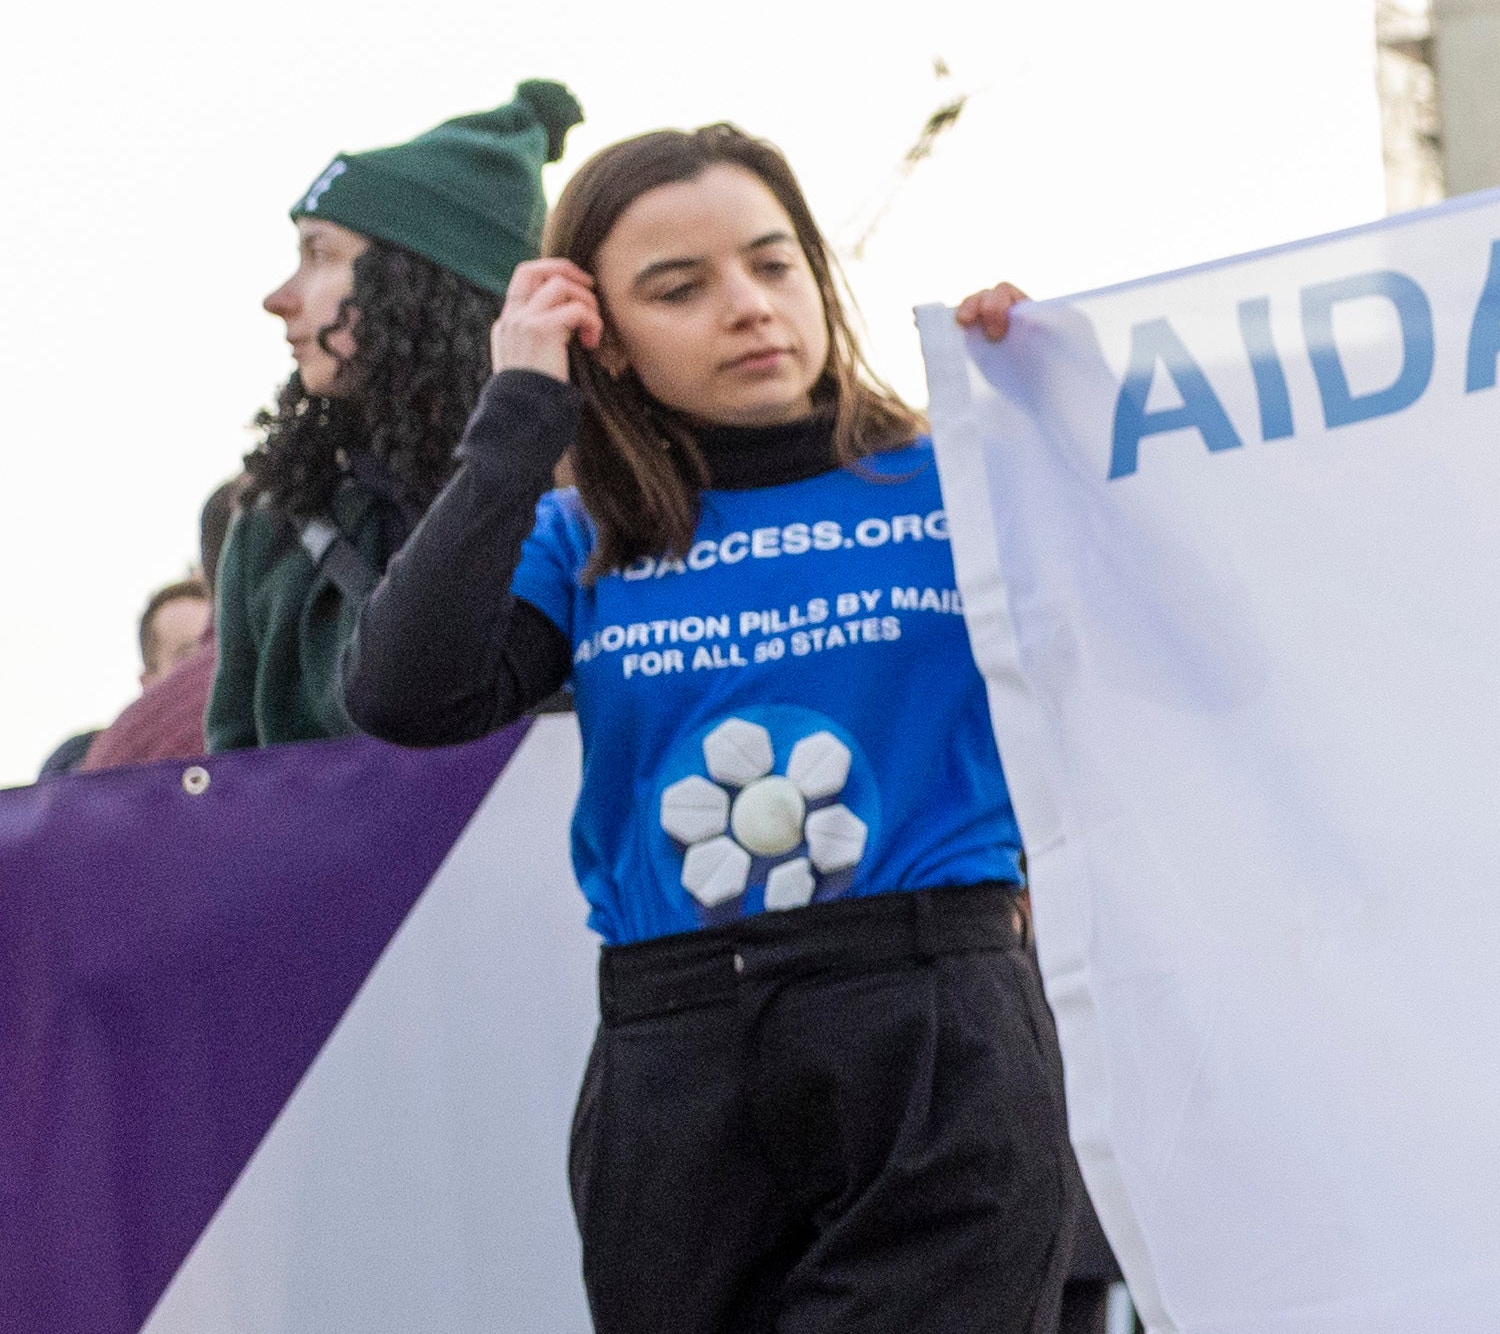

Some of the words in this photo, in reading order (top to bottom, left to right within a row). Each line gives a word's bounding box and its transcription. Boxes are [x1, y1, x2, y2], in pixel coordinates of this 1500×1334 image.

[739, 598, 829, 637] PILLS
[836, 588, 882, 618] BY
[622, 647, 685, 679] FOR
[691, 643, 748, 671] ALL
[753, 637, 786, 664] 50
[790, 615, 902, 656] STATES
